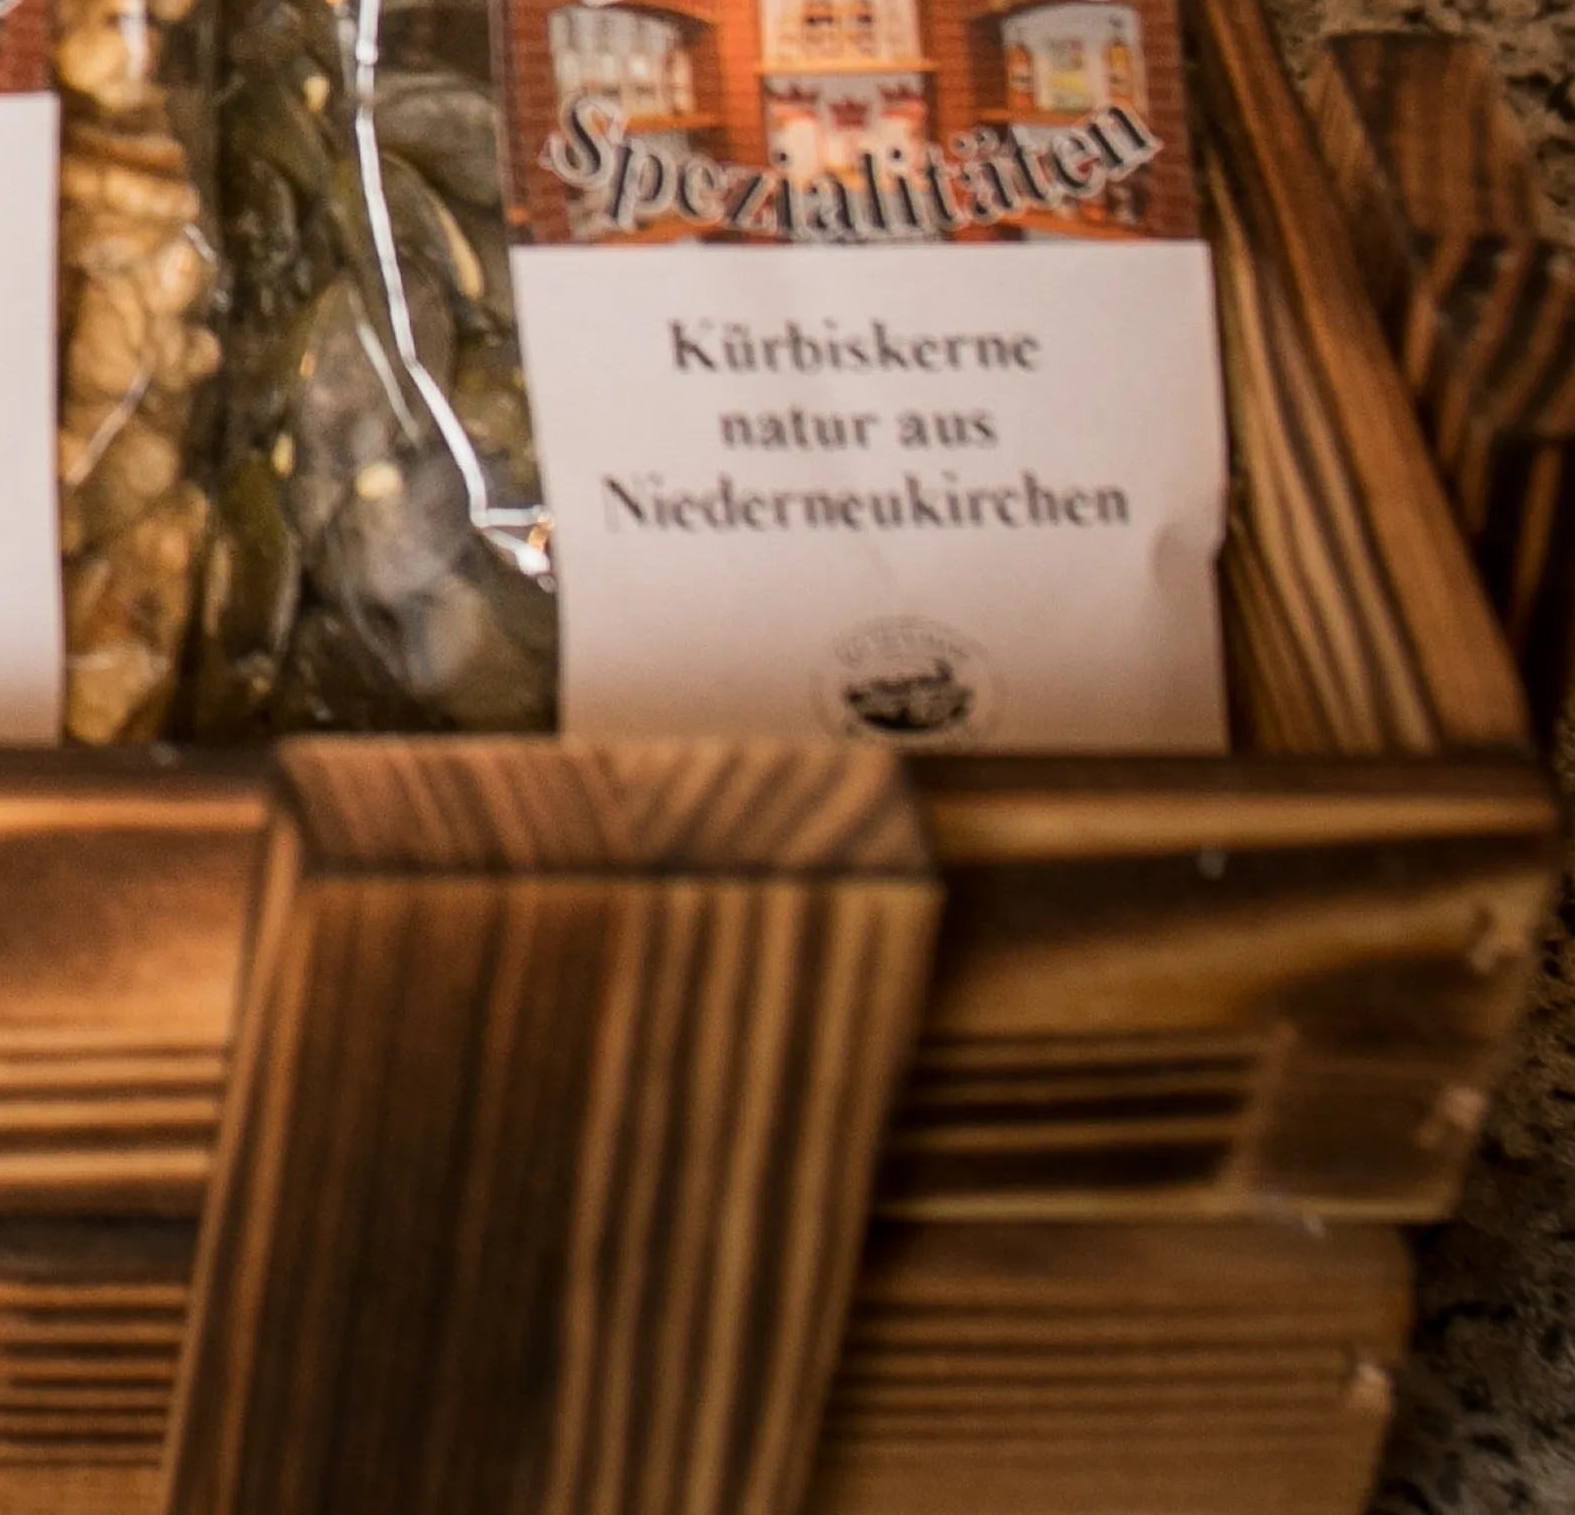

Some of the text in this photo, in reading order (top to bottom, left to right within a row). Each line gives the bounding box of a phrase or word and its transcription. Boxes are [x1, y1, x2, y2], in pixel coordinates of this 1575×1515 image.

[537, 98, 1164, 238] Spezialitäten
[670, 318, 1041, 374] Kürbiskerne
[717, 406, 998, 451] natur aus
[602, 470, 1130, 532] Niederneukirchen
